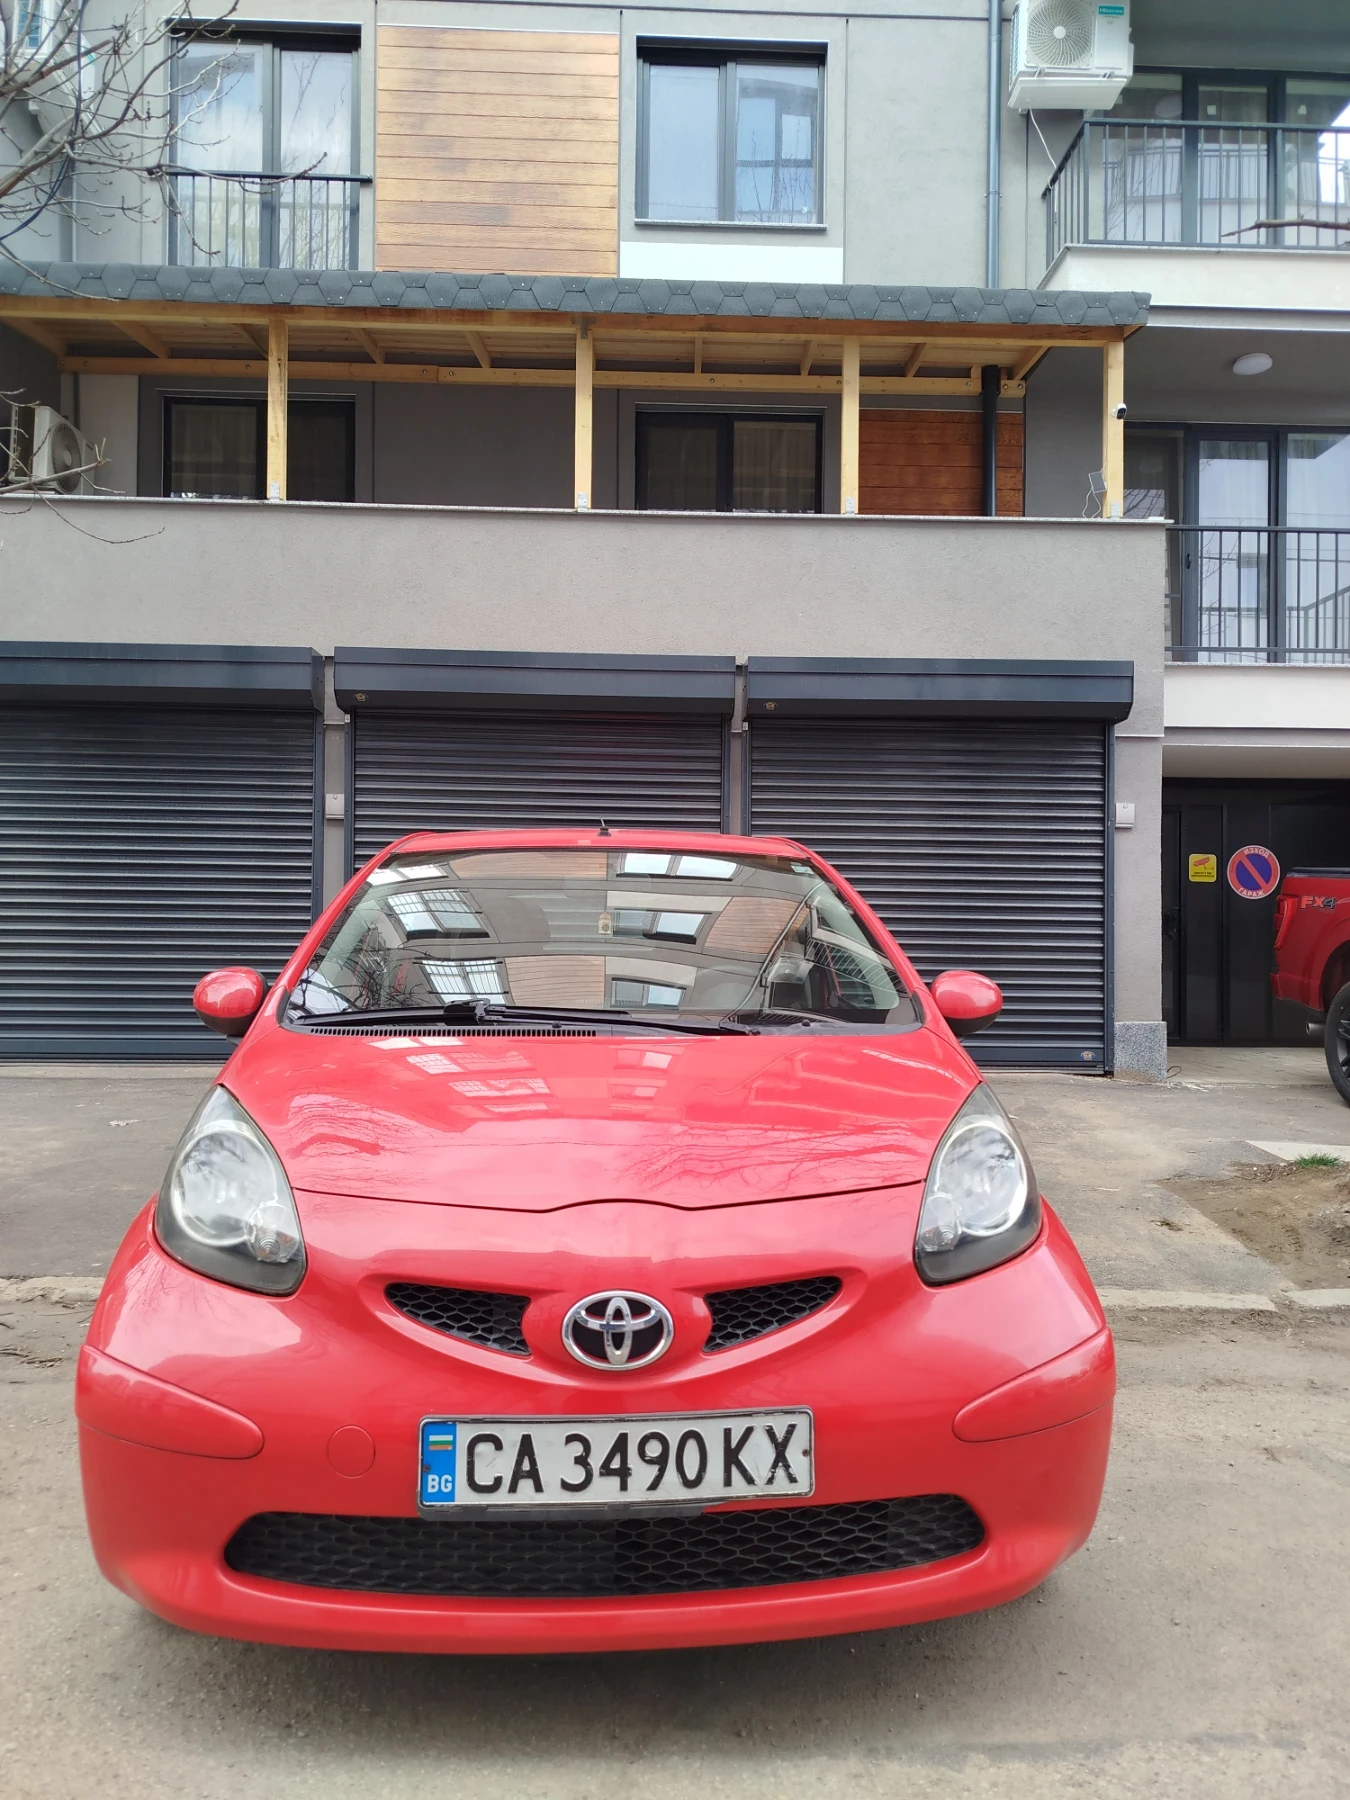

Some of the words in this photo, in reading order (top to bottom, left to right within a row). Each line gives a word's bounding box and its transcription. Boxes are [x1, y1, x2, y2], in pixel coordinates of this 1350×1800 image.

[1243, 847, 1270, 858] ИЗХОД
[1238, 887, 1265, 897] ГАРАЖ
[1300, 895, 1337, 909] FX4
[466, 1432, 544, 1494] CA
[560, 1428, 708, 1493] 3490
[722, 1422, 799, 1488] KX
[427, 1474, 453, 1493] BG
